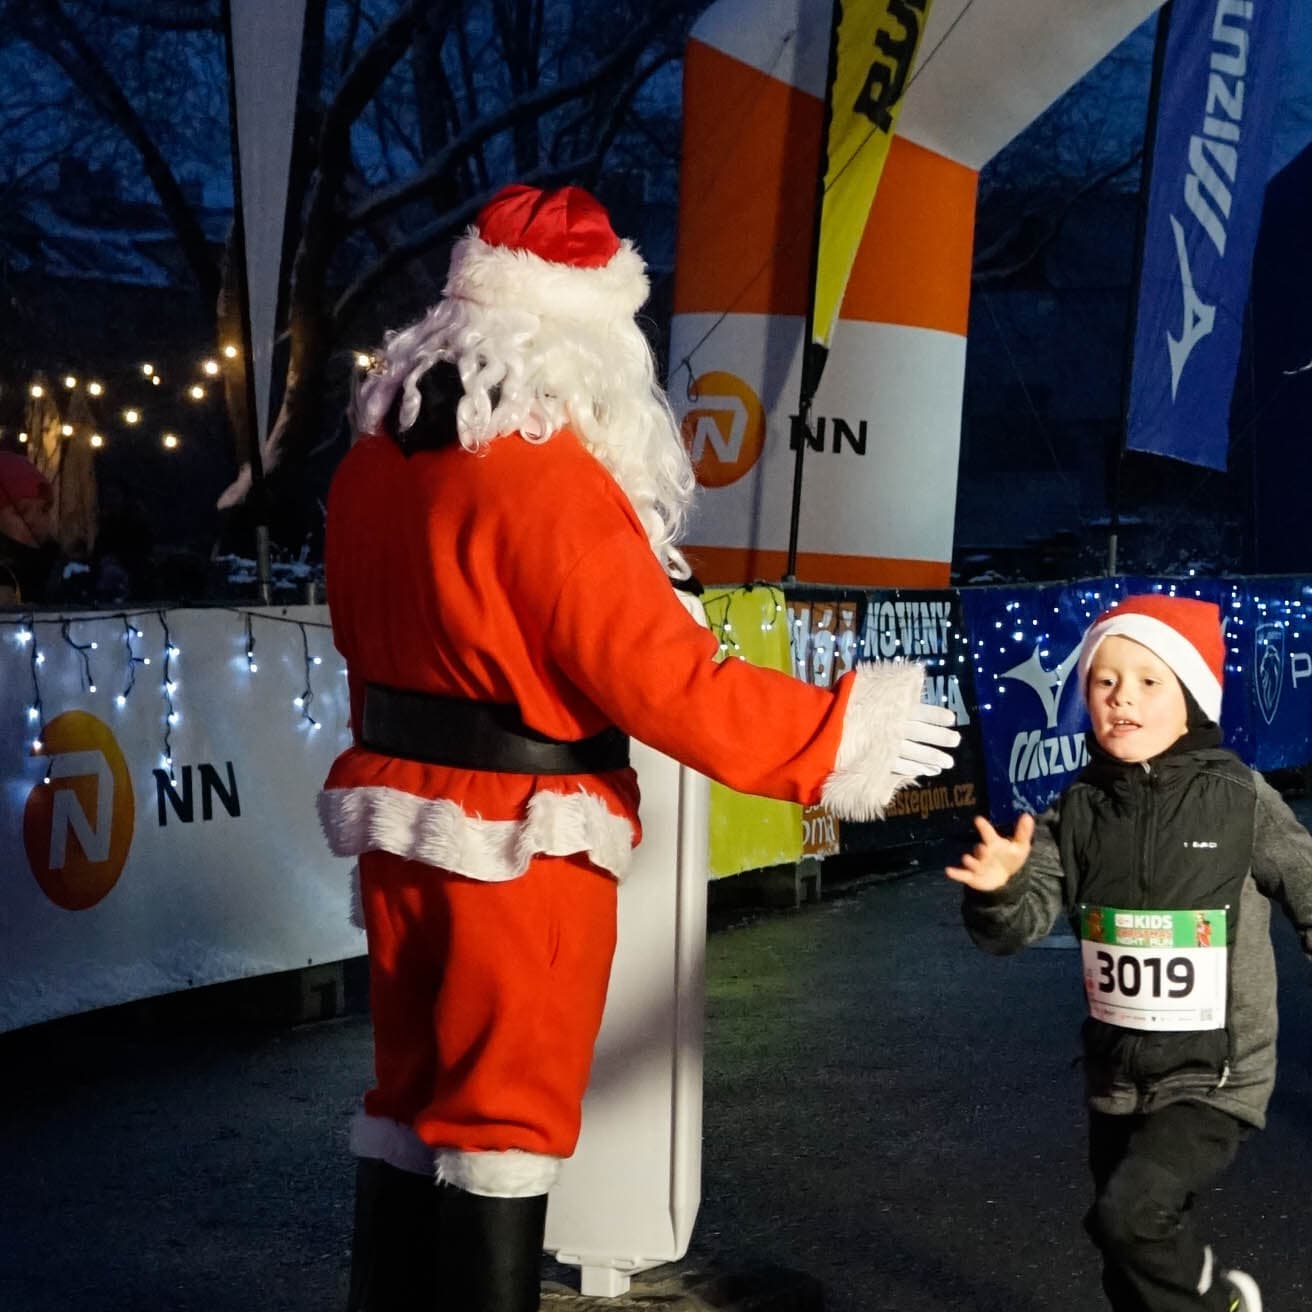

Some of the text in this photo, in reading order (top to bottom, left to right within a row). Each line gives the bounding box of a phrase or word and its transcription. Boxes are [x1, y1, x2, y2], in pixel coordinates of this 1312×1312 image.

[789, 415, 867, 455] NN
[863, 601, 951, 657] NOVINY
[153, 761, 241, 826] NN
[1134, 914, 1173, 929] KIDS
[1096, 950, 1195, 999] 3019
